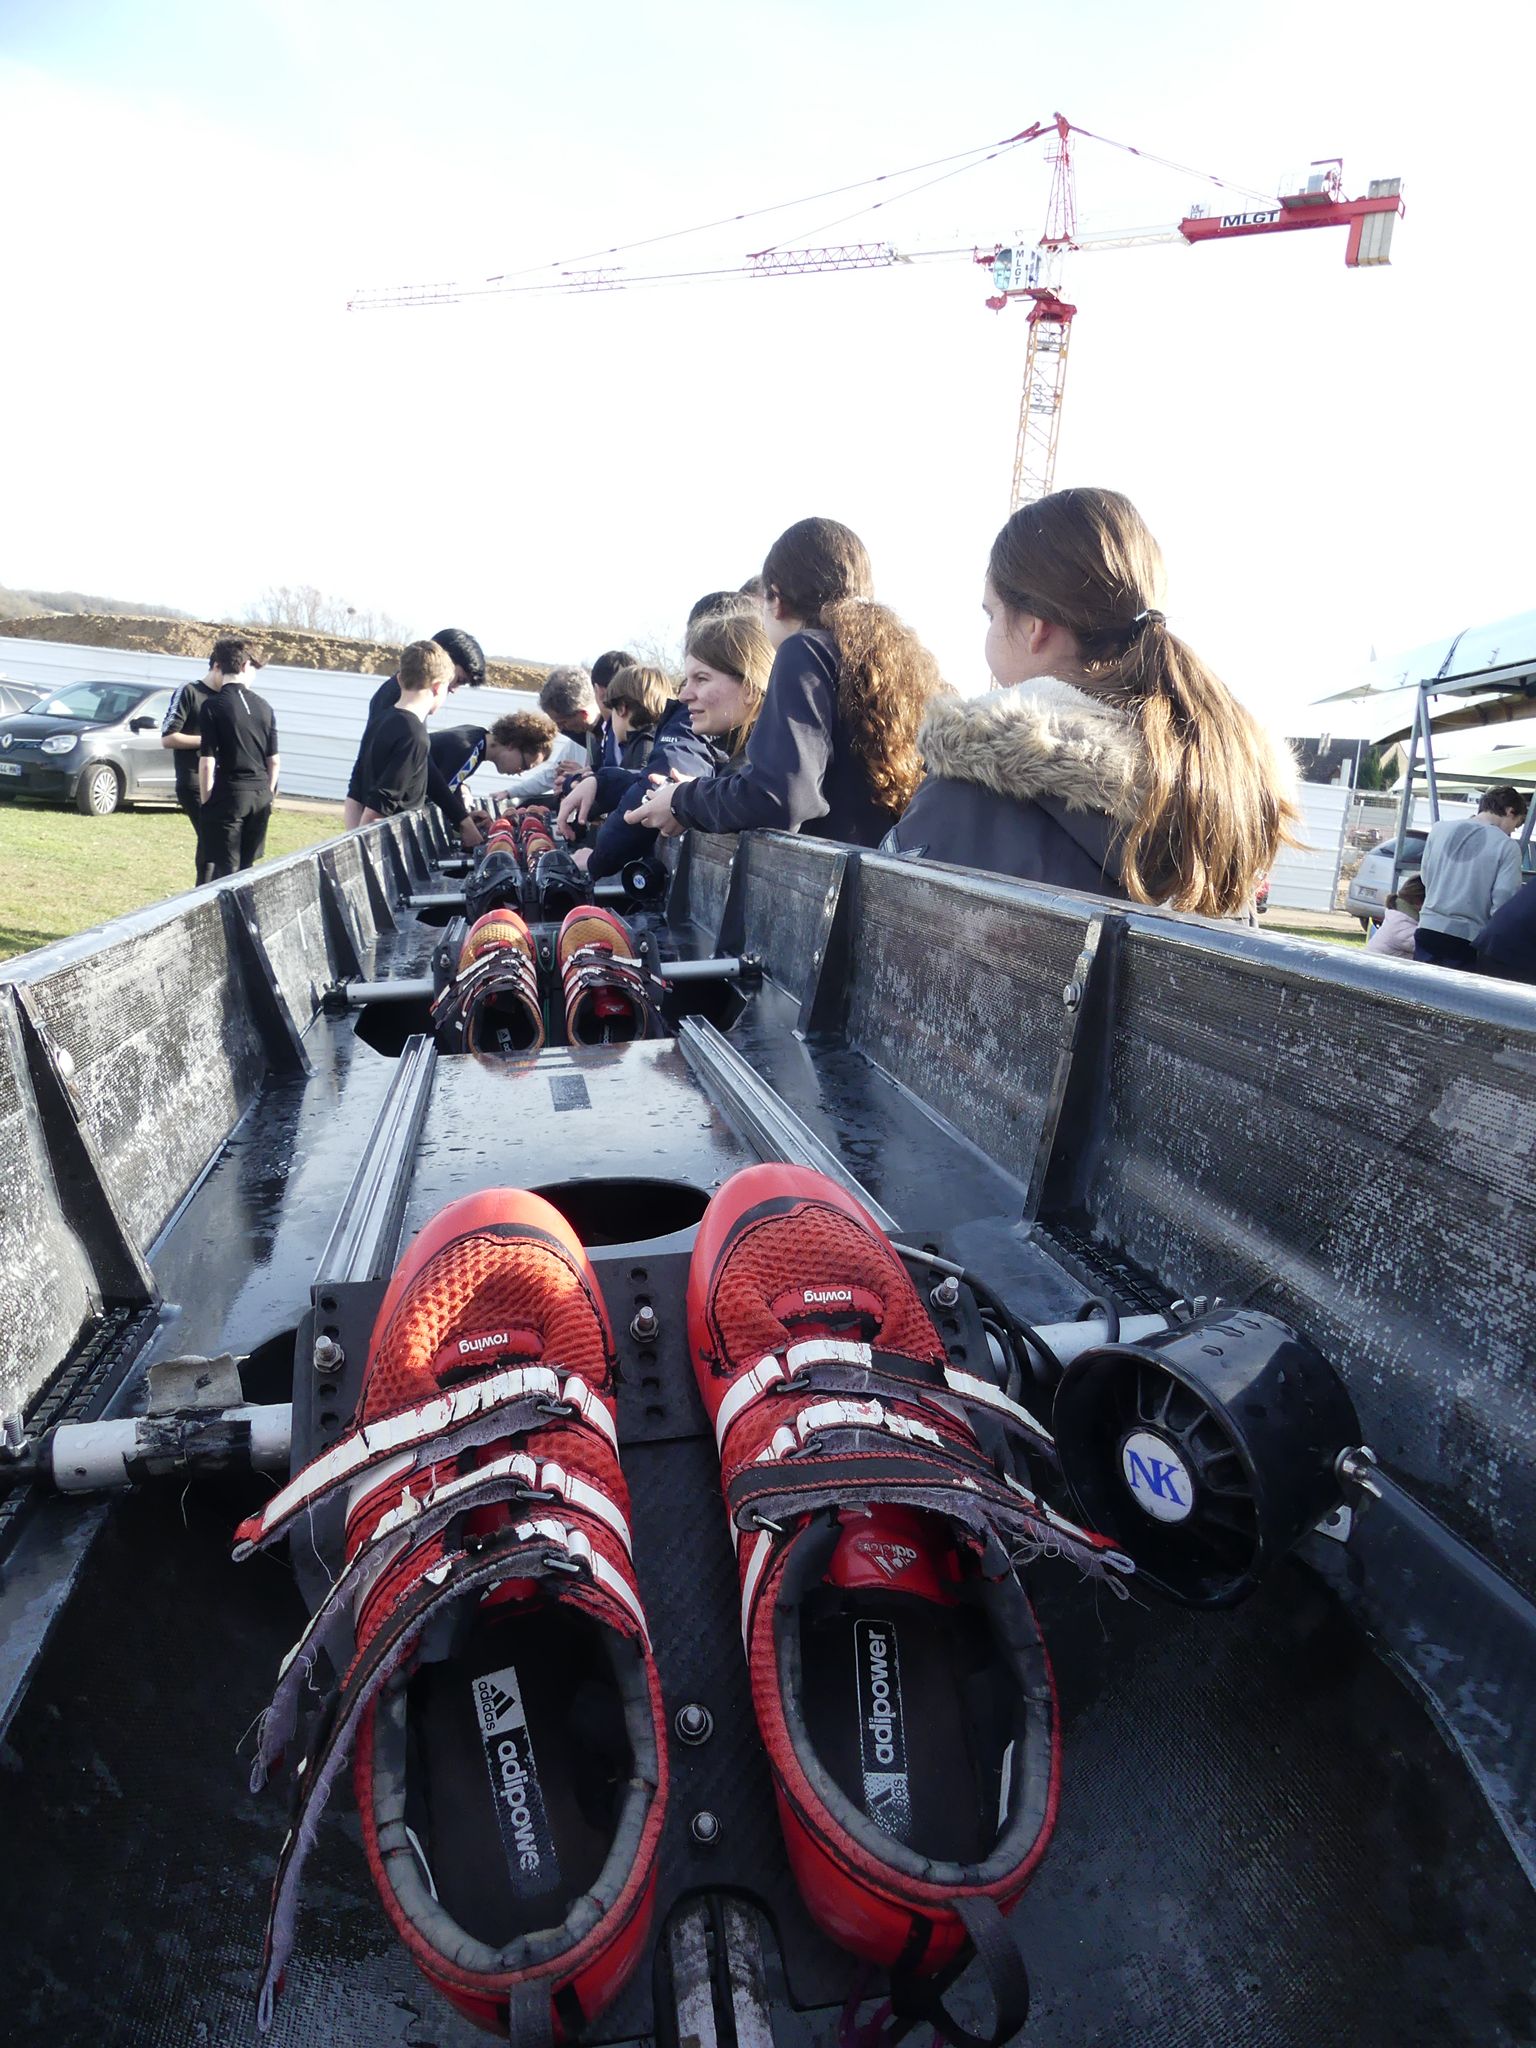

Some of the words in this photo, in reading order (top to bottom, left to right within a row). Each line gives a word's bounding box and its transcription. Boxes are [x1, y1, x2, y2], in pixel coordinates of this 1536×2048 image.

[1222, 211, 1279, 227] MLGT
[1014, 249, 1025, 285] MLGT
[804, 1290, 852, 1304] rowing
[458, 1333, 508, 1354] rowing
[1126, 1449, 1186, 1507] NK
[478, 1681, 495, 1731] adidas
[868, 1629, 897, 1764] adipower
[497, 1740, 541, 1878] adipowe
